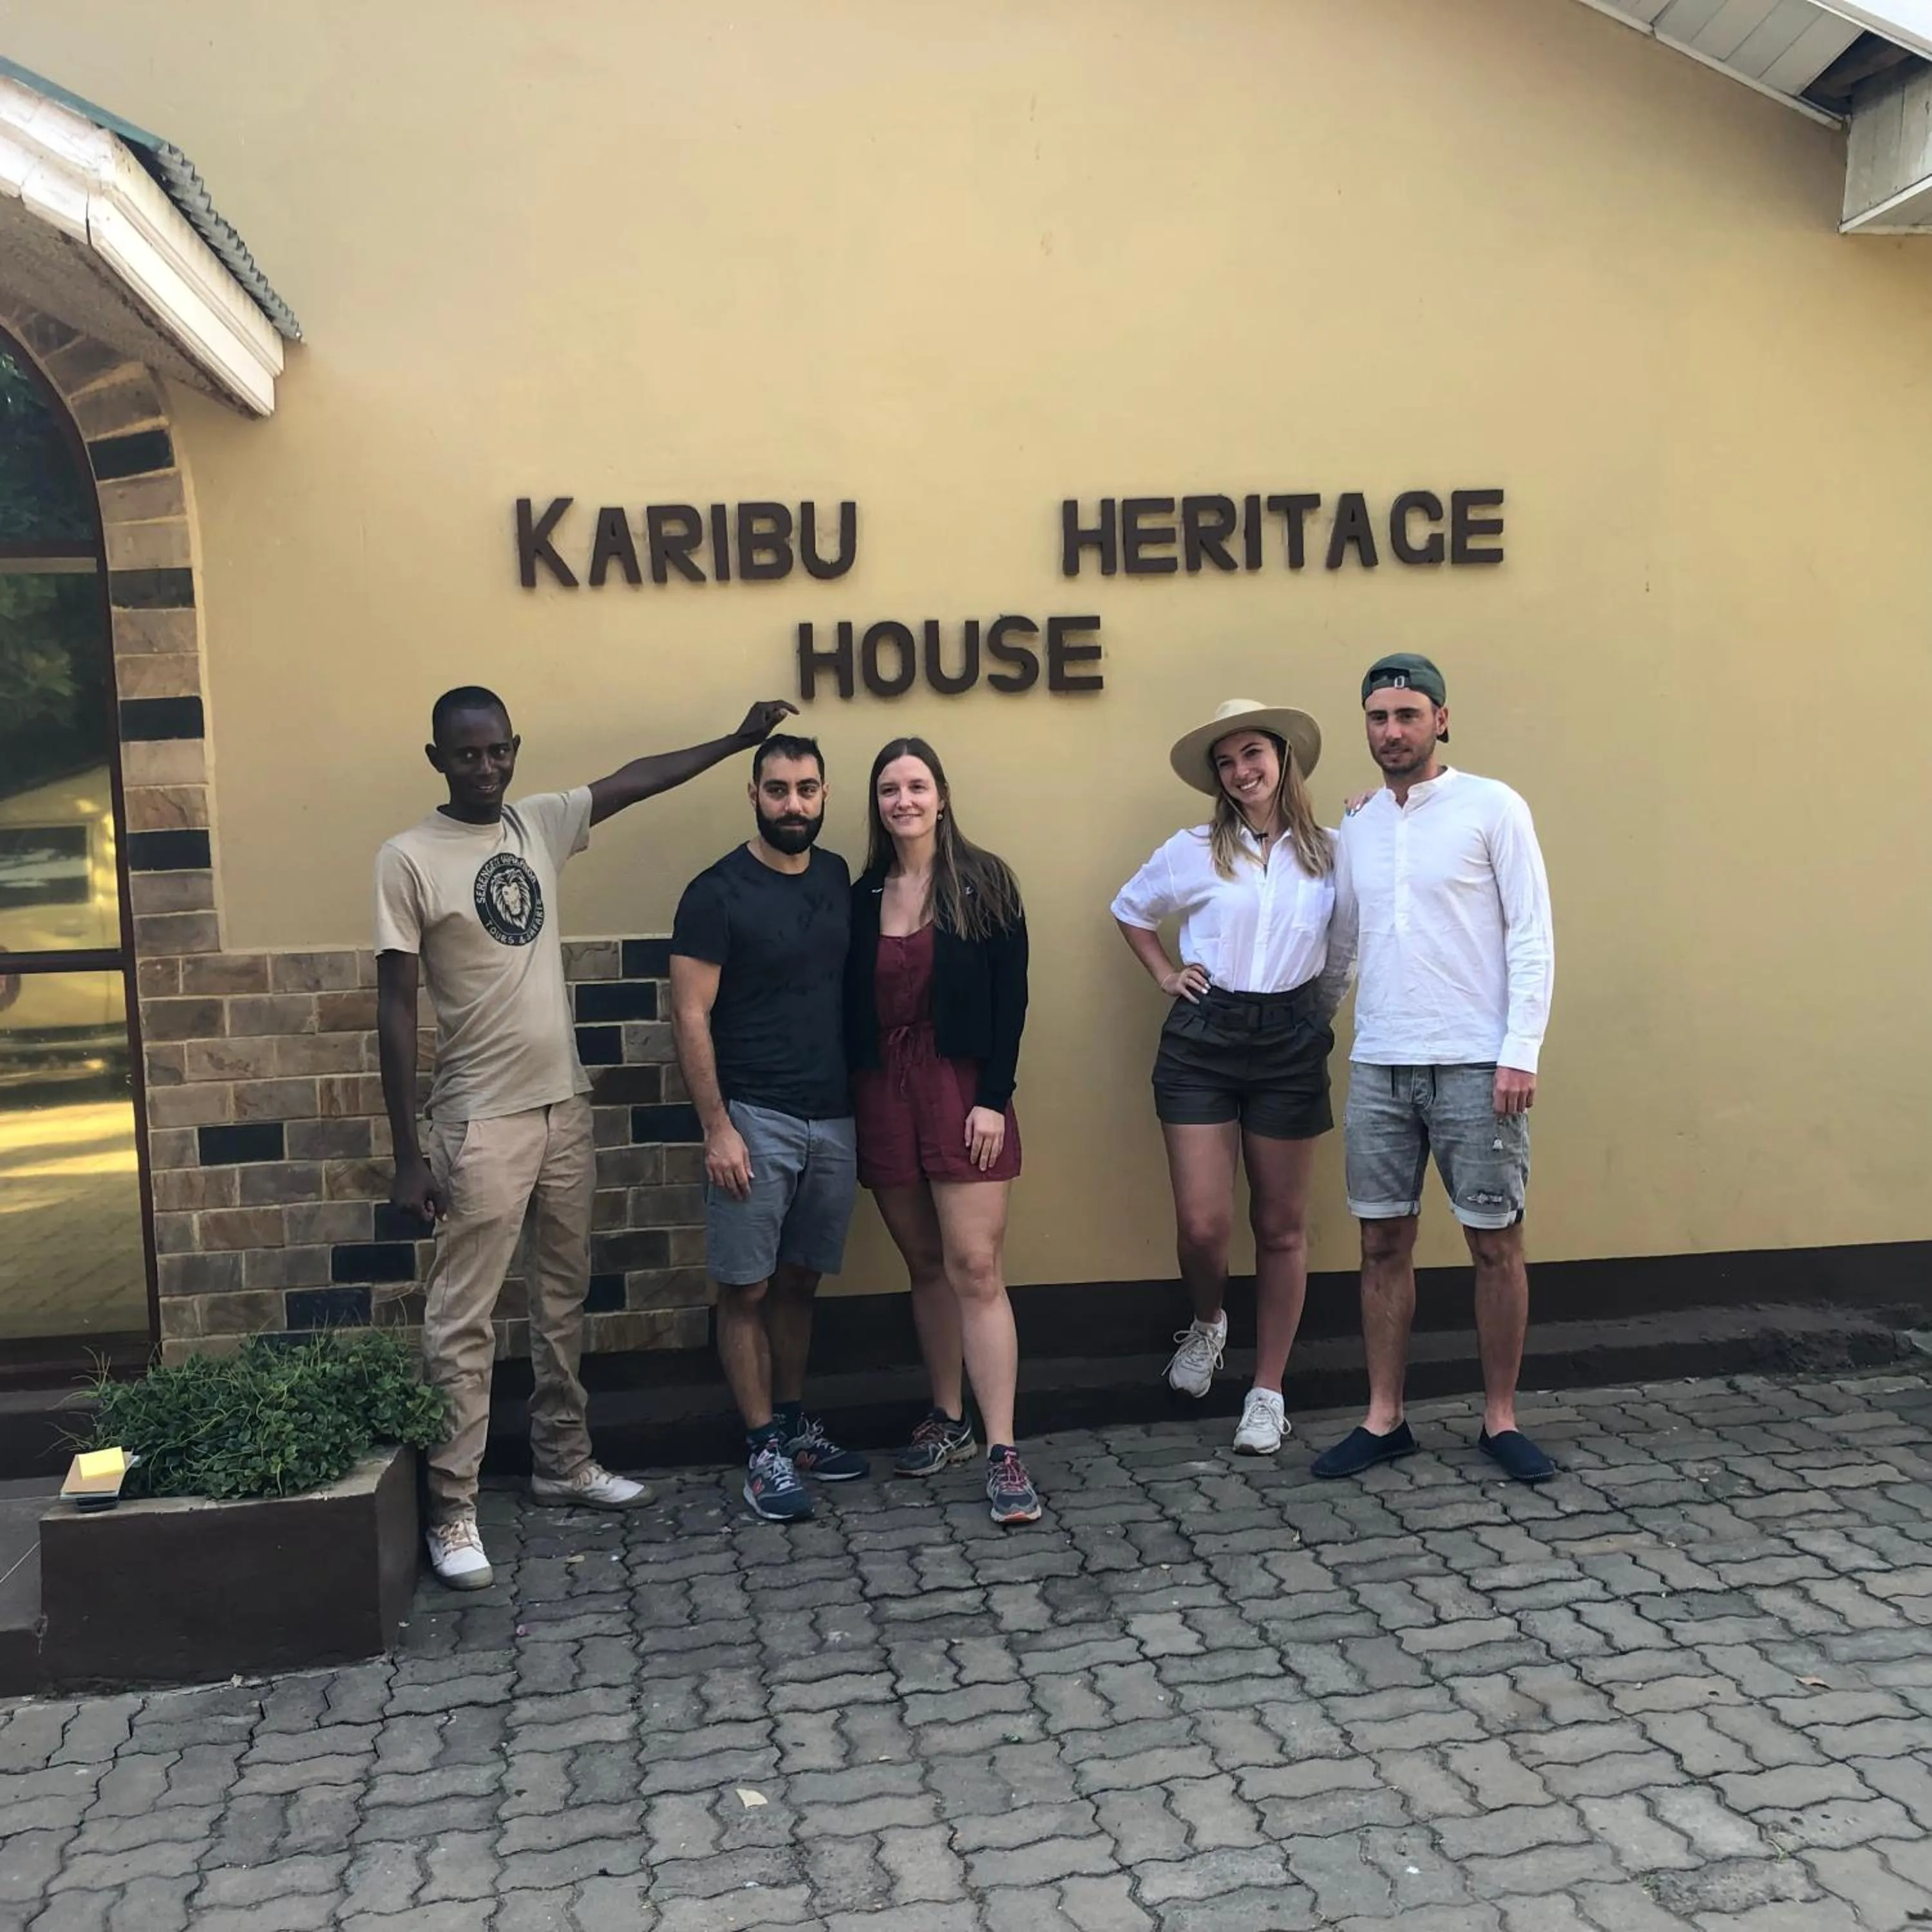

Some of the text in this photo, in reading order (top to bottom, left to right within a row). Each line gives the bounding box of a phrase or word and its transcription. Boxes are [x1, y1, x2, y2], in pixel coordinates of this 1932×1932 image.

[516, 489, 1504, 589] KARIBU HERITAGE
[796, 614, 1104, 703] HOUSE
[486, 920, 515, 944] TOURS
